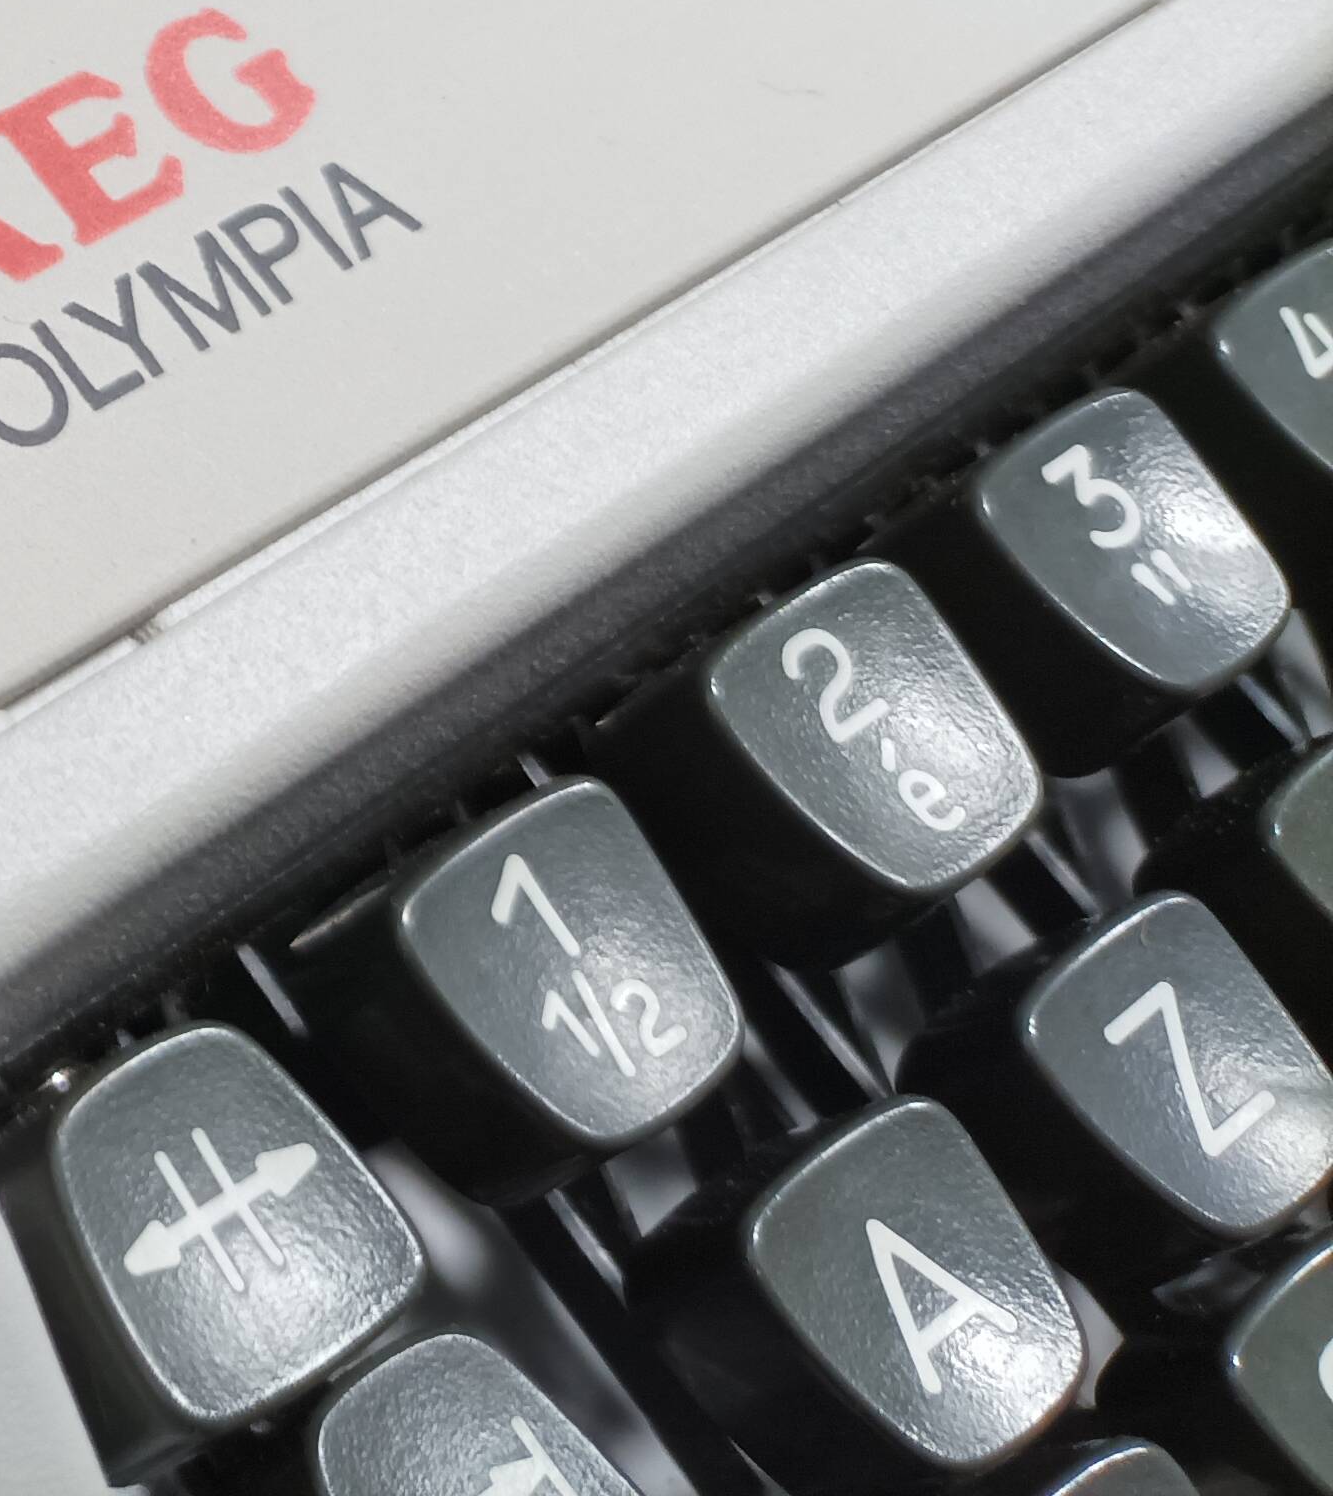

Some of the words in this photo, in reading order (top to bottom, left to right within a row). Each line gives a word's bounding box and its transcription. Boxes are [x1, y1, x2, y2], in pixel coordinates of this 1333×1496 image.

[1039, 442, 1142, 549] 3
[781, 627, 890, 744] 2
[880, 737, 966, 832] é
[490, 853, 582, 958] 1
[1102, 980, 1276, 1157] Z
[864, 1218, 1019, 1395] A
